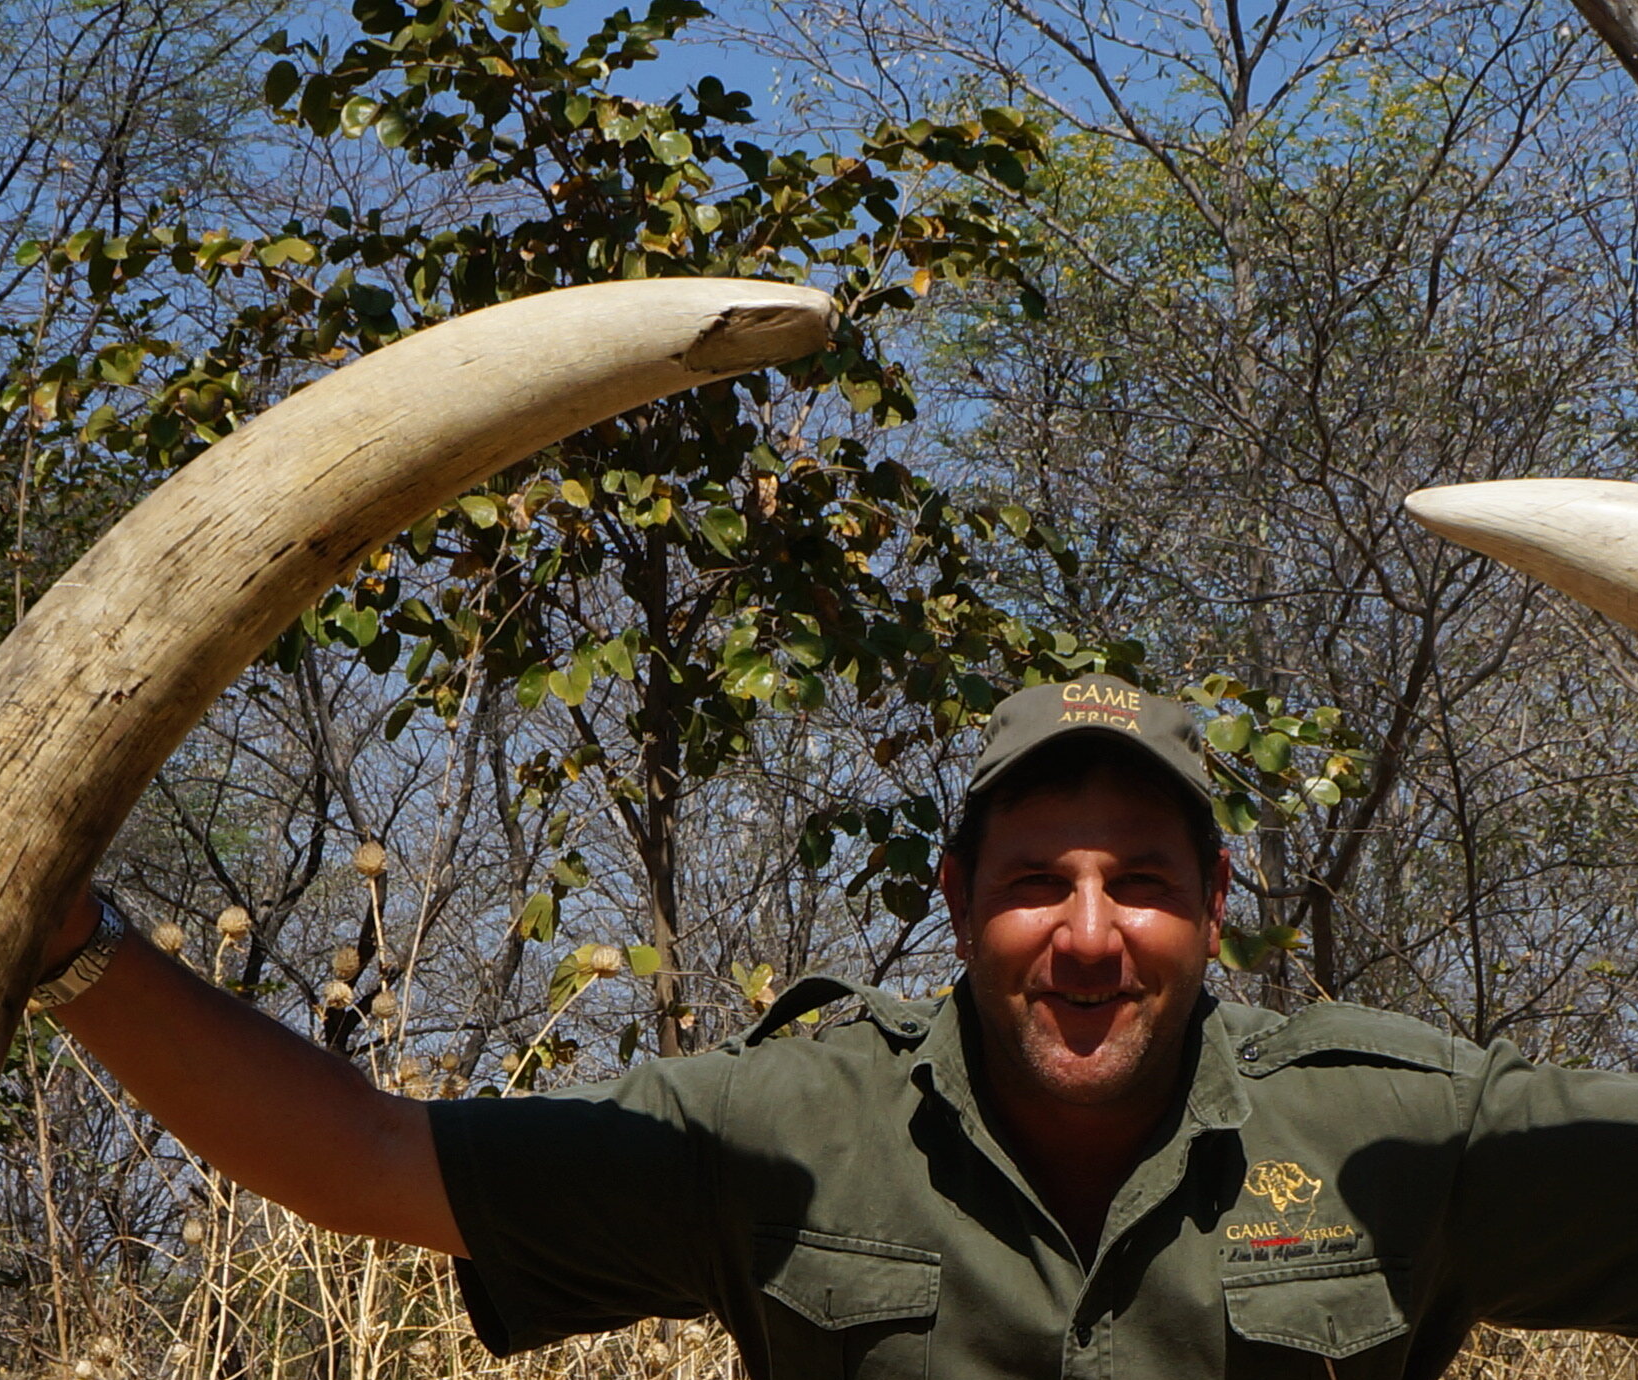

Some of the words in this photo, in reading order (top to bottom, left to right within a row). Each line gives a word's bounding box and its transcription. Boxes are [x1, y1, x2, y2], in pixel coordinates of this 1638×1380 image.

[1062, 683, 1141, 711] GAME
[1058, 711, 1142, 735] AFRICA
[1226, 1221, 1281, 1240] GAME
[1303, 1224, 1355, 1240] AFRICA
